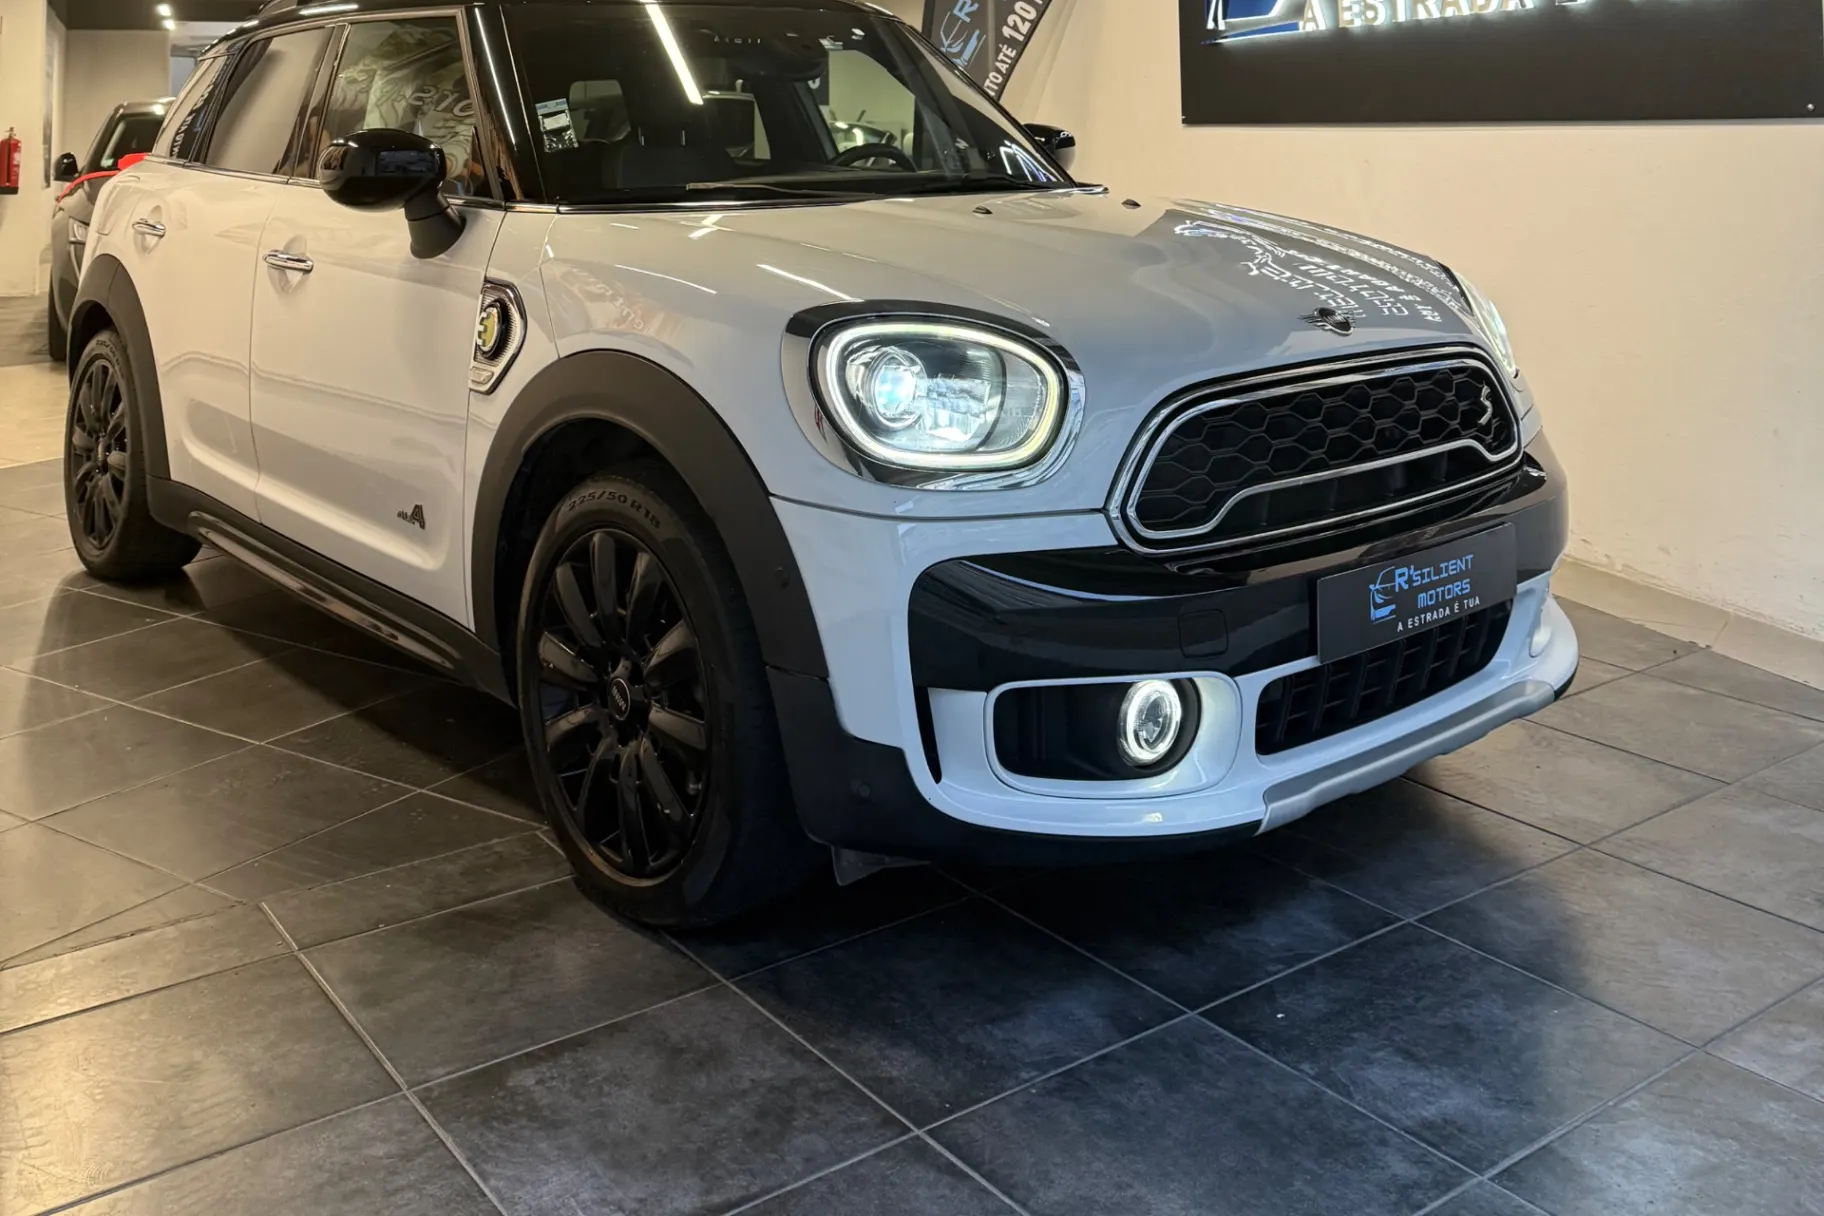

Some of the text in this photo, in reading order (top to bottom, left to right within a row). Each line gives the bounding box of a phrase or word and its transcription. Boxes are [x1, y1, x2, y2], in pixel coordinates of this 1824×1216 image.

[1001, 1, 1037, 42] 120
[994, 43, 1017, 73] ATÉ
[983, 69, 1003, 98] TO
[1395, 554, 1474, 592] R'SILIENT
[1417, 579, 1471, 609] MOTORS
[1397, 596, 1481, 632] A ESTRADA É TUA
